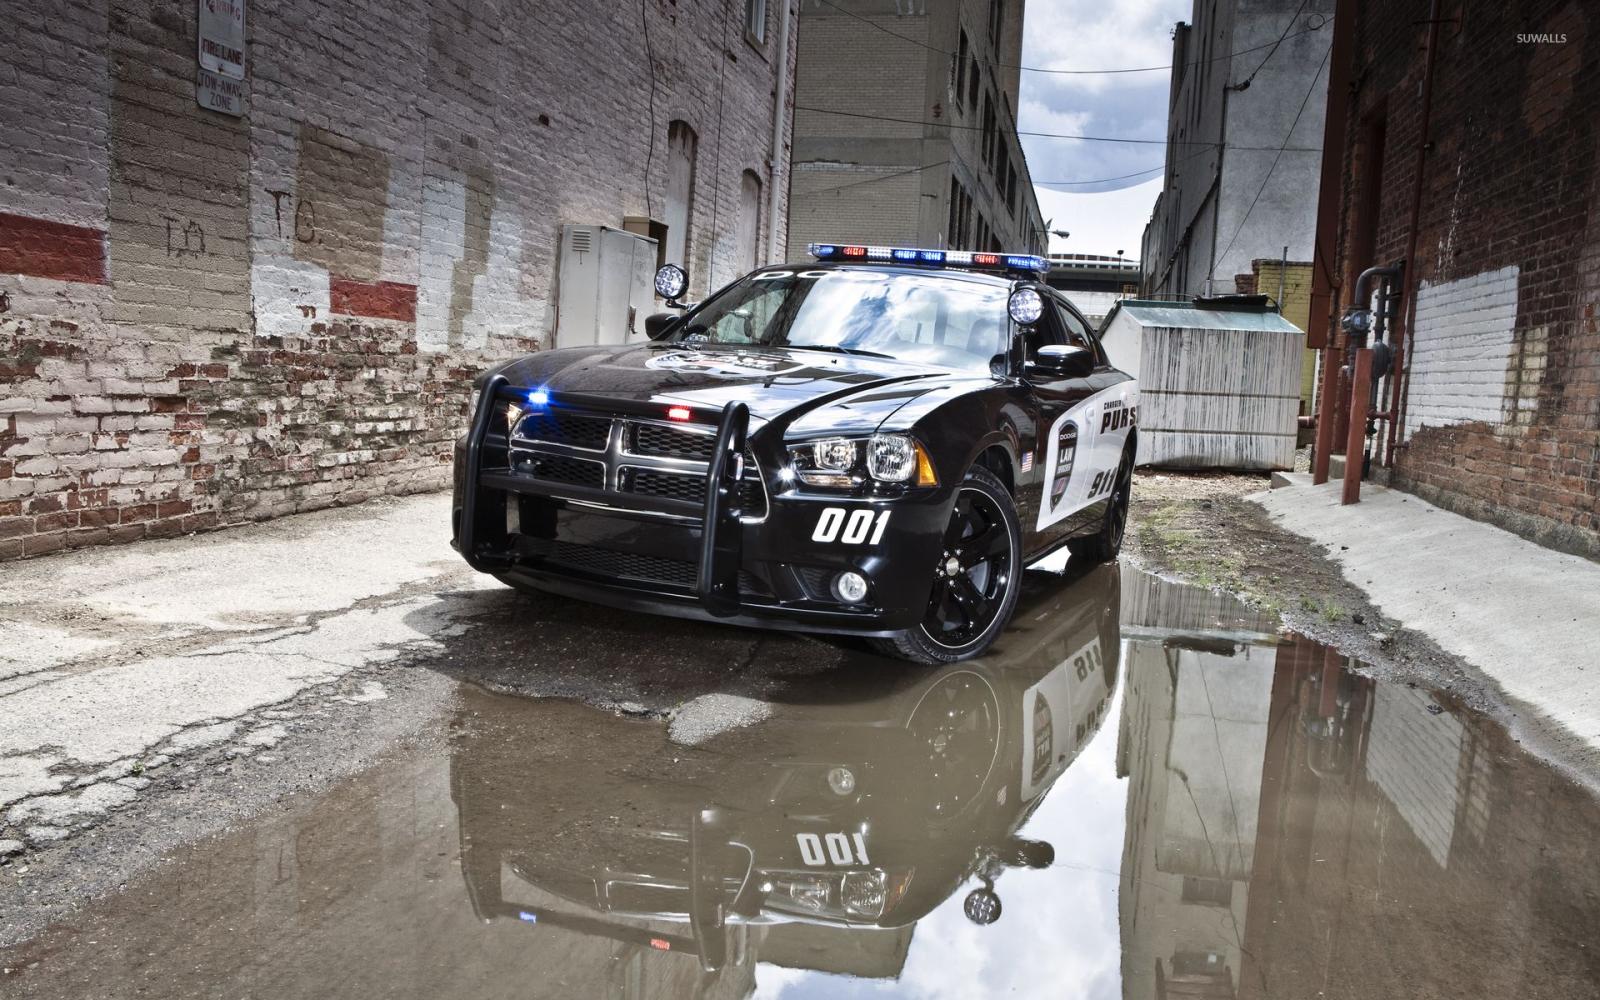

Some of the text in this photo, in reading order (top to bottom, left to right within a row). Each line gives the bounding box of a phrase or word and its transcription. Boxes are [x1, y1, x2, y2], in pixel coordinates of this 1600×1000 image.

[202, 38, 242, 66] FIRE LANE
[200, 72, 240, 97] TOW-AWAY
[210, 91, 232, 111] ZONE
[1060, 432, 1077, 440] DODGE
[1060, 447, 1074, 463] LAW
[1087, 466, 1118, 500] 911
[811, 507, 892, 545] 001
